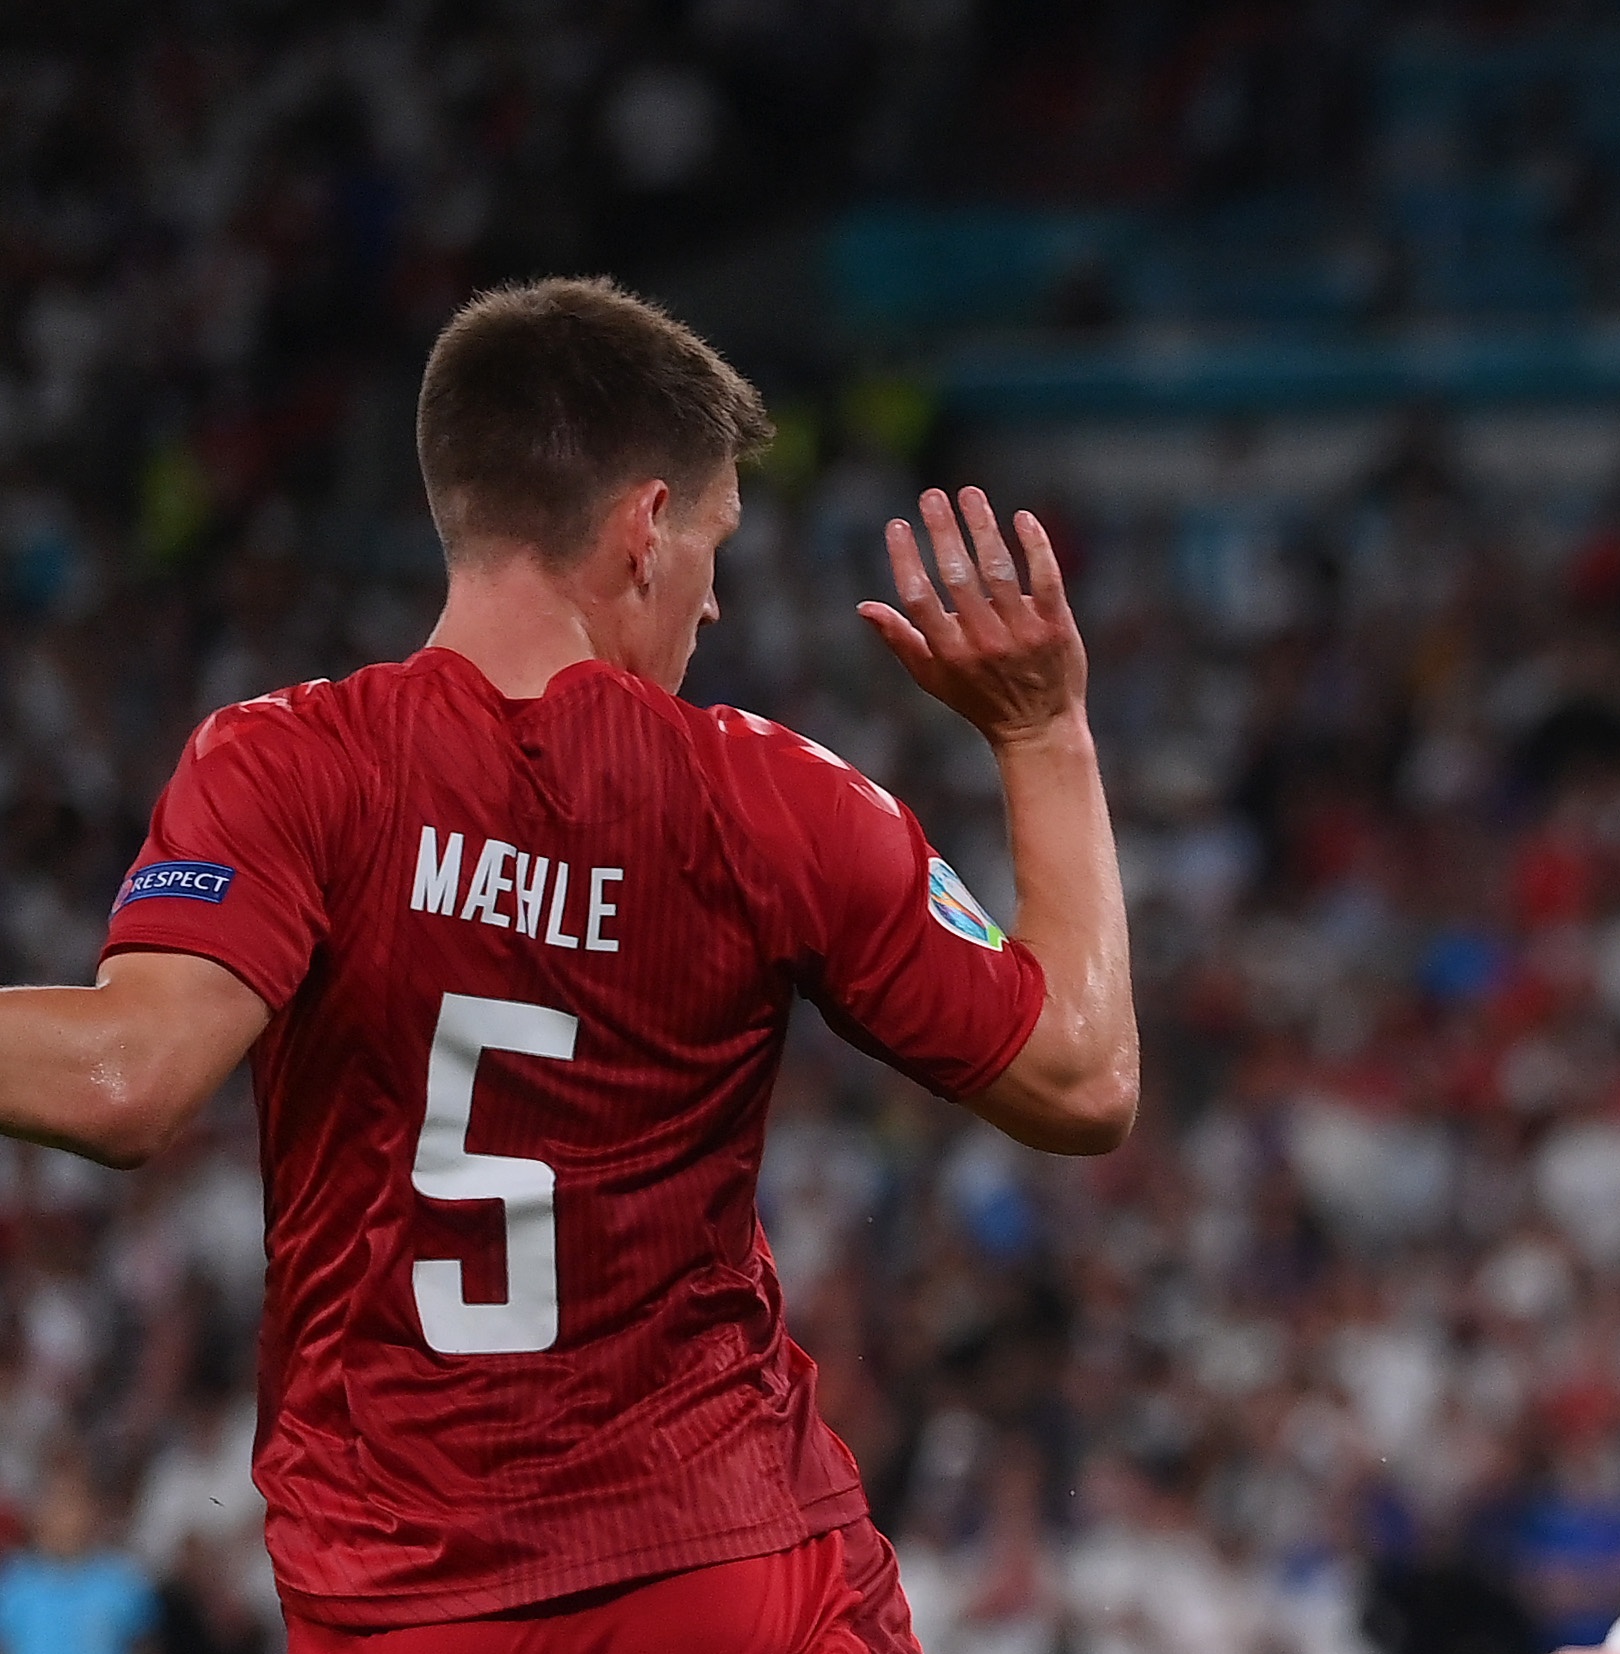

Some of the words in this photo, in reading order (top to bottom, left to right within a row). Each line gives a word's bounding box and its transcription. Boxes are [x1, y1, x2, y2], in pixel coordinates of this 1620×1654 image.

[130, 871, 230, 893] RESPECT
[410, 825, 624, 952] MÆHLE
[411, 991, 578, 1355] 5
